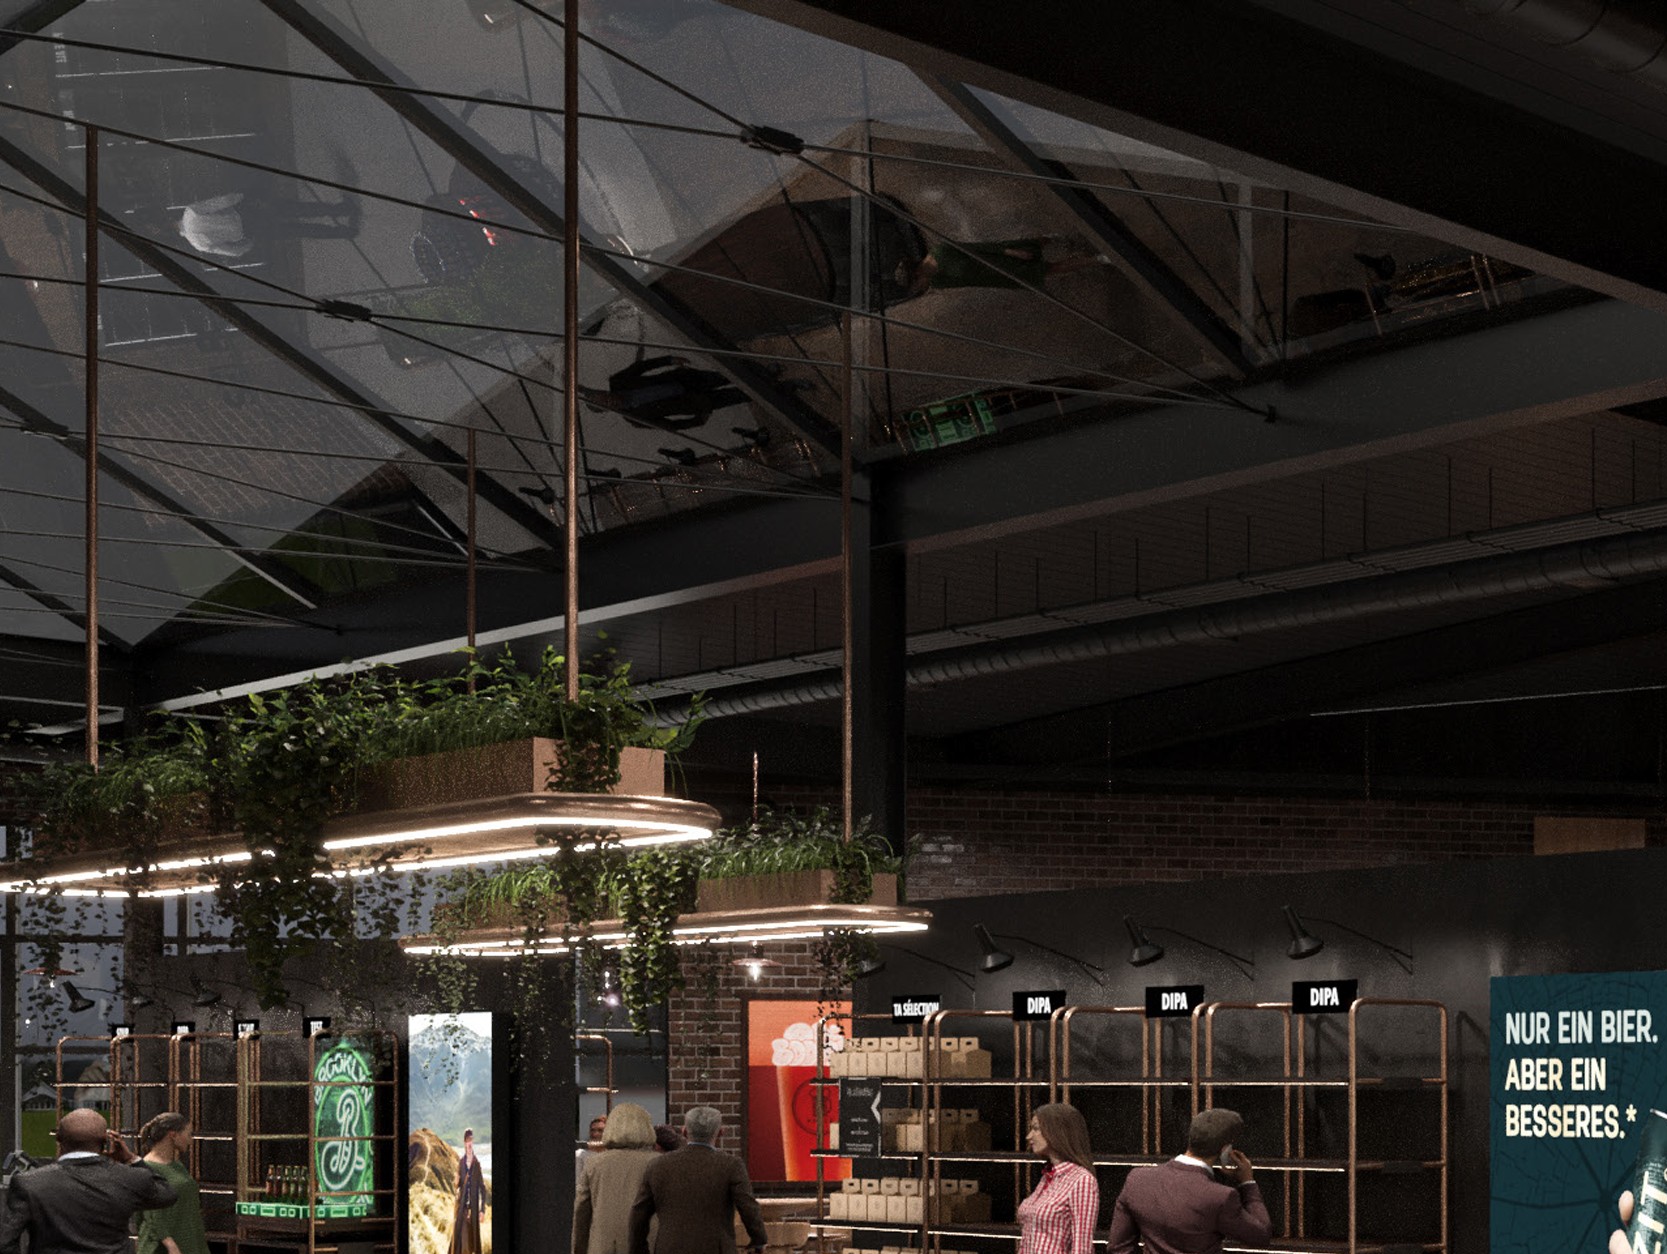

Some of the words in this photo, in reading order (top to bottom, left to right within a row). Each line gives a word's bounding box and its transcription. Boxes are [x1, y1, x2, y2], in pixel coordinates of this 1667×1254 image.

[1027, 996, 1051, 1014] DIPA
[1161, 991, 1188, 1010] DIPA
[1310, 986, 1339, 1006] DIPA
[893, 1003, 902, 1016] TA
[903, 999, 940, 1016] SÉLECTION
[1505, 1011, 1550, 1045] NUR
[1558, 1010, 1593, 1044] EIN
[1601, 1009, 1658, 1043] BIER.
[1504, 1058, 1563, 1091] ABER
[1571, 1057, 1606, 1091] EIN
